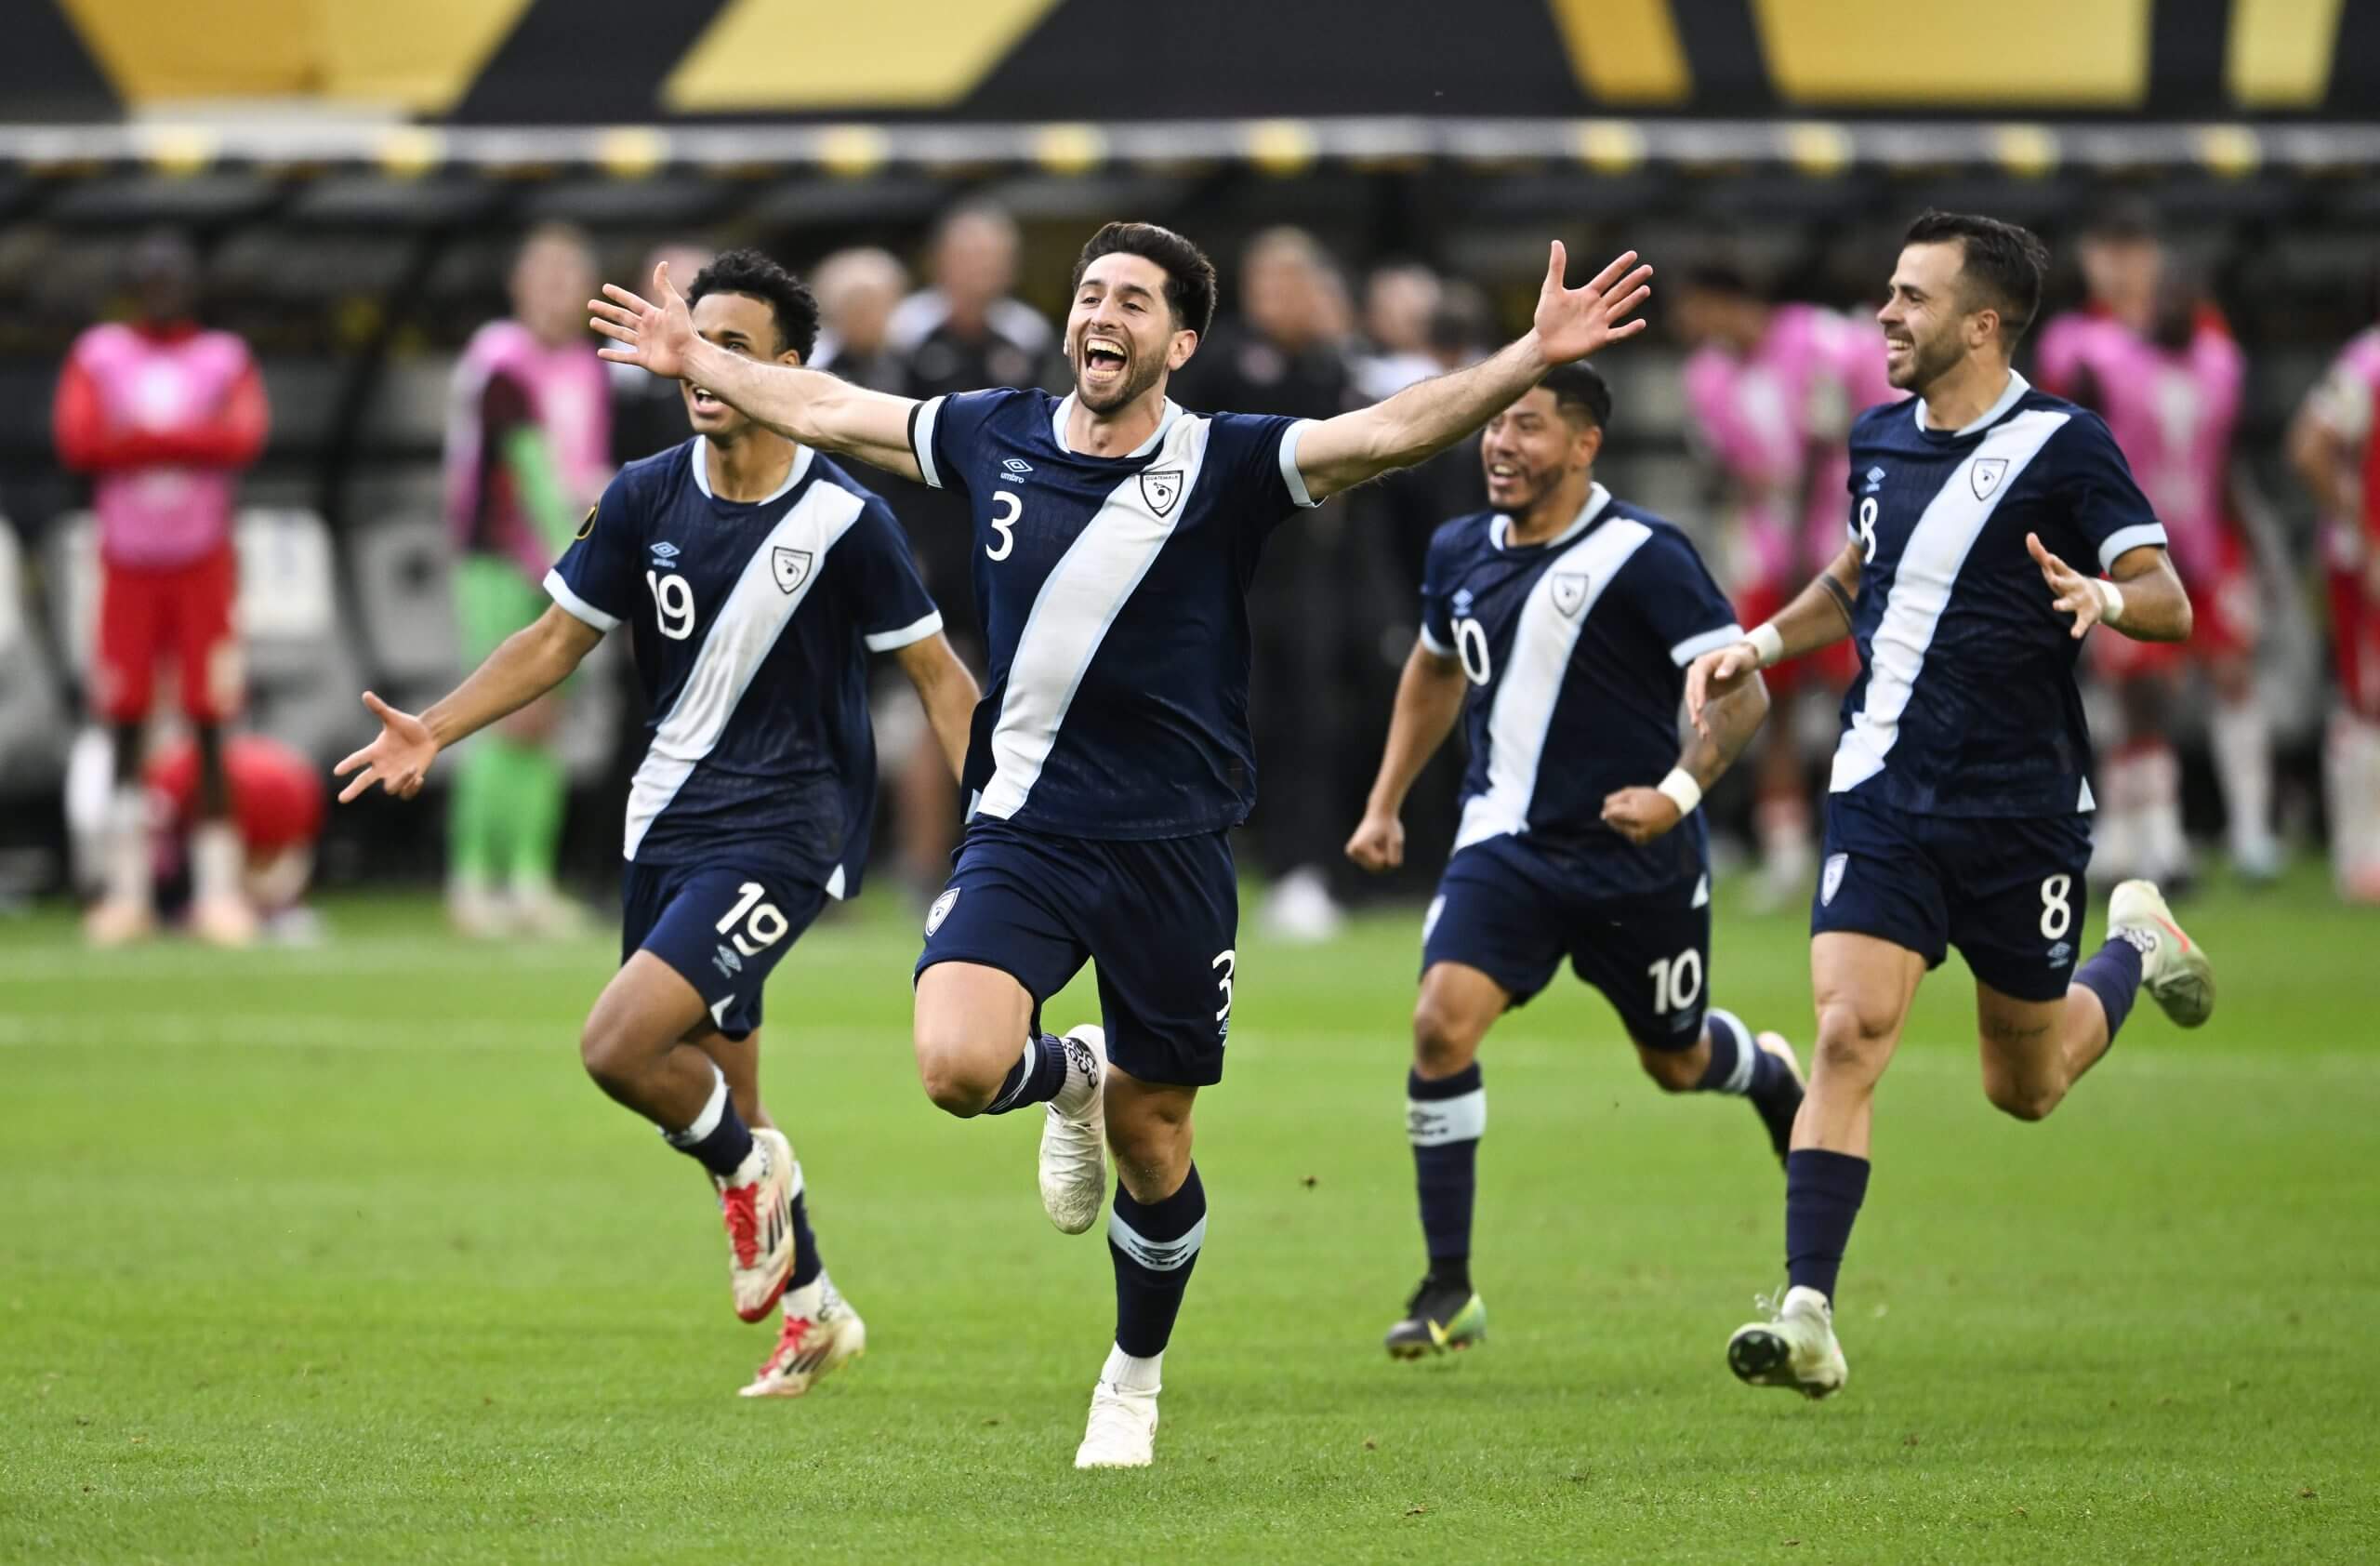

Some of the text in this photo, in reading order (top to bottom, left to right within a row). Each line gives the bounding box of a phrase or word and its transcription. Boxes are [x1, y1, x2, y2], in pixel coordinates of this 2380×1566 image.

[999, 471, 1025, 484] umbro
[985, 490, 1023, 562] 3
[1859, 497, 1879, 565] 8
[646, 570, 695, 641] 19
[715, 882, 789, 957] 19
[2040, 874, 2071, 940] 8
[1211, 949, 1236, 1022] 3
[1647, 948, 1702, 1015] 10
